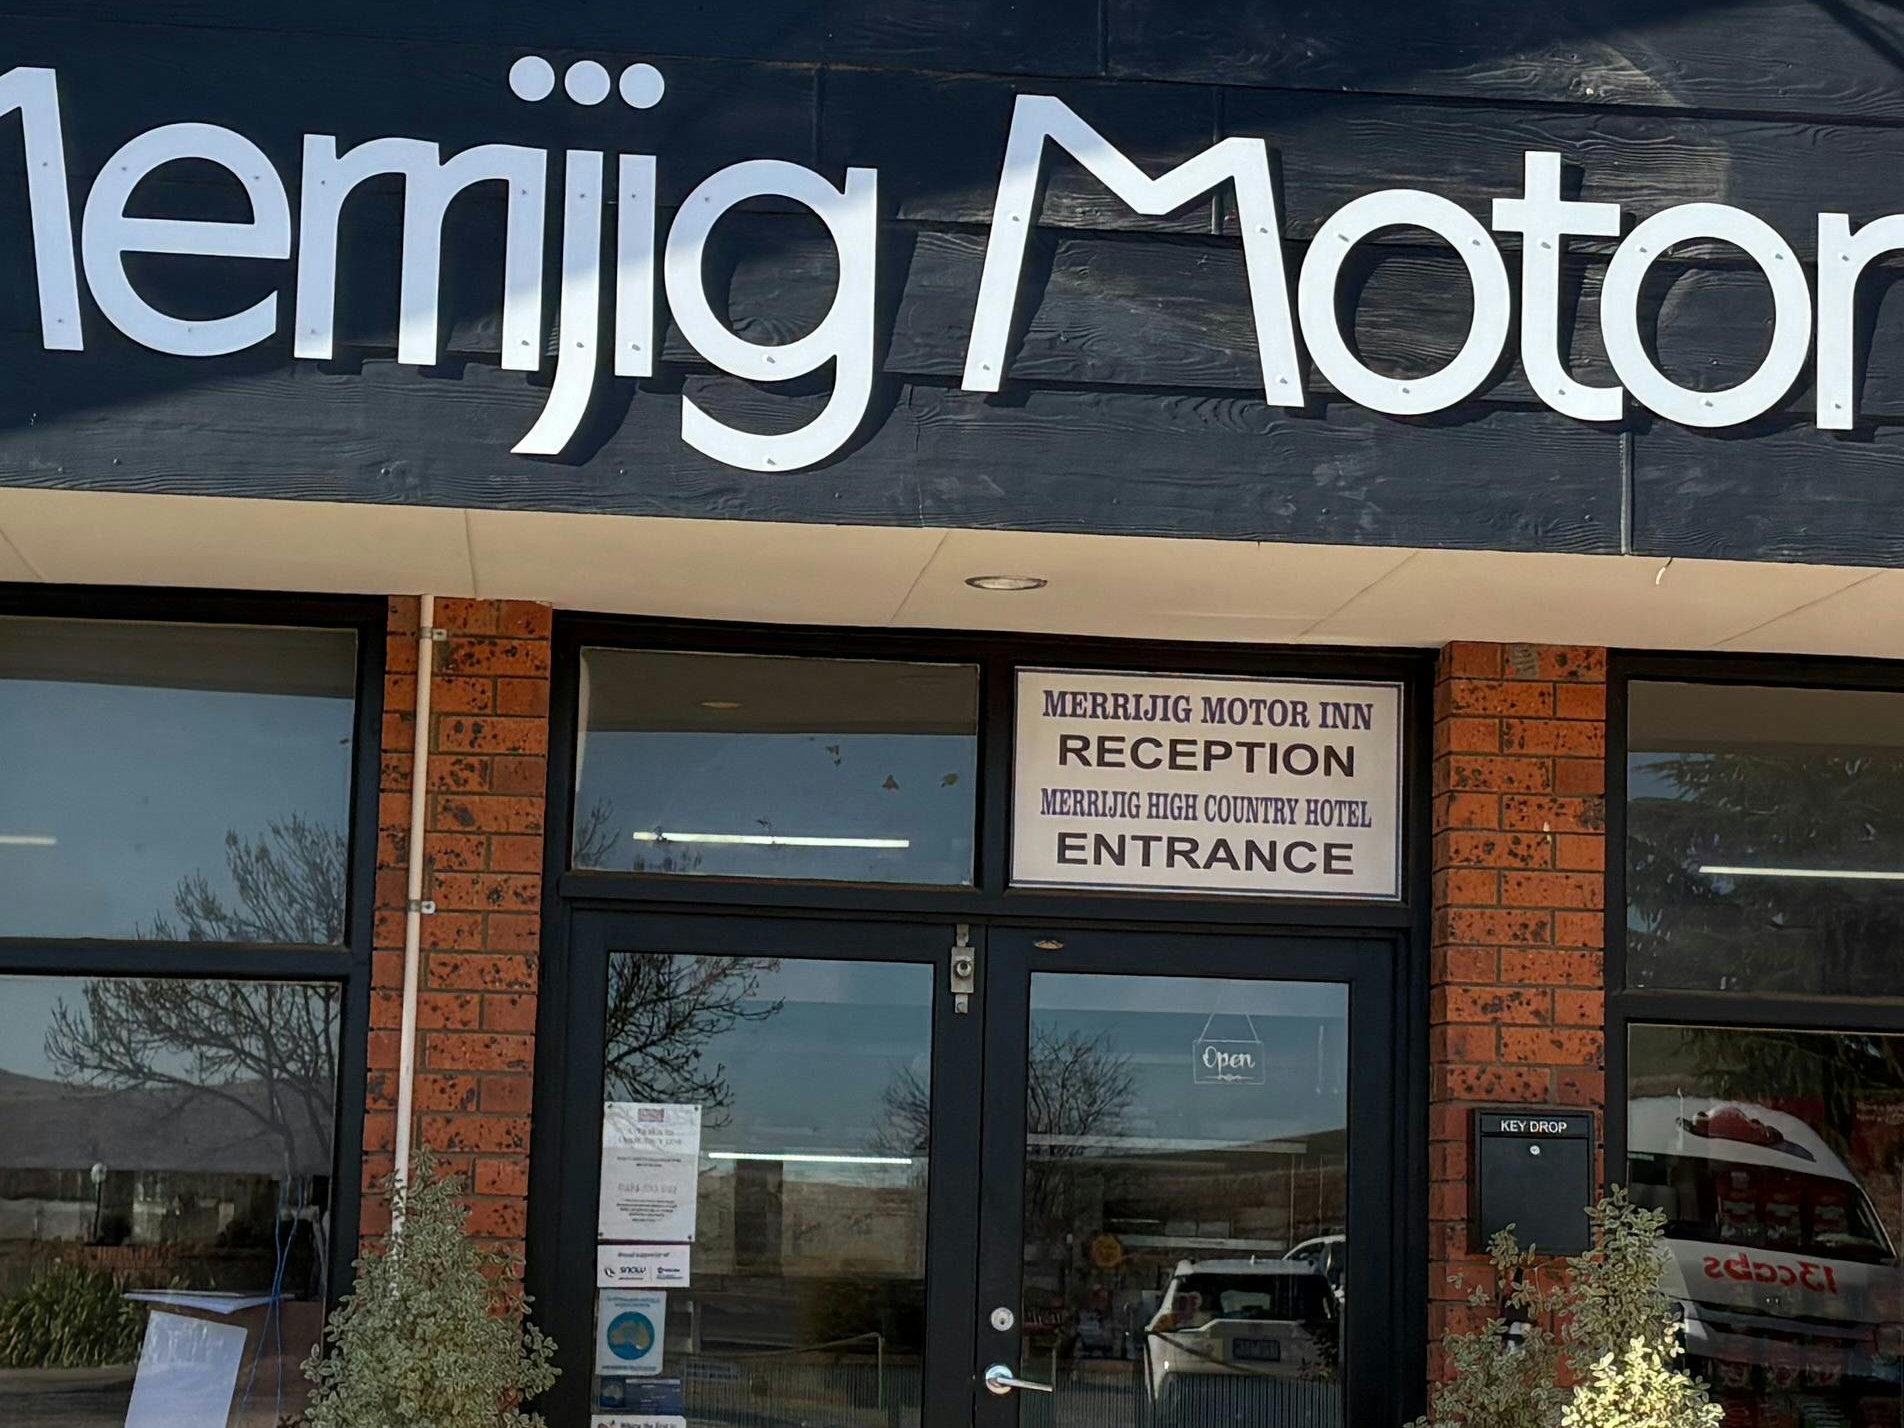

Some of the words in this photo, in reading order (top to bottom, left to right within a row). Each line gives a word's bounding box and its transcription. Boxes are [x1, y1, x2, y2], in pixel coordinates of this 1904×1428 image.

[1042, 689, 1193, 724] MERRIJIG
[1200, 696, 1311, 729] MOTOR
[1318, 701, 1374, 731] INN
[1058, 733, 1355, 778] RECEPTION
[1040, 787, 1142, 820] MERRIJIG
[1146, 791, 1199, 822] HIGH
[1204, 794, 1300, 826] COUNTRY
[1304, 798, 1373, 829] HOTEL
[1056, 831, 1354, 876] ENTRANCE
[1202, 1045, 1256, 1076] Open
[1500, 1119, 1527, 1132] KEY
[1529, 1120, 1568, 1133] DROP
